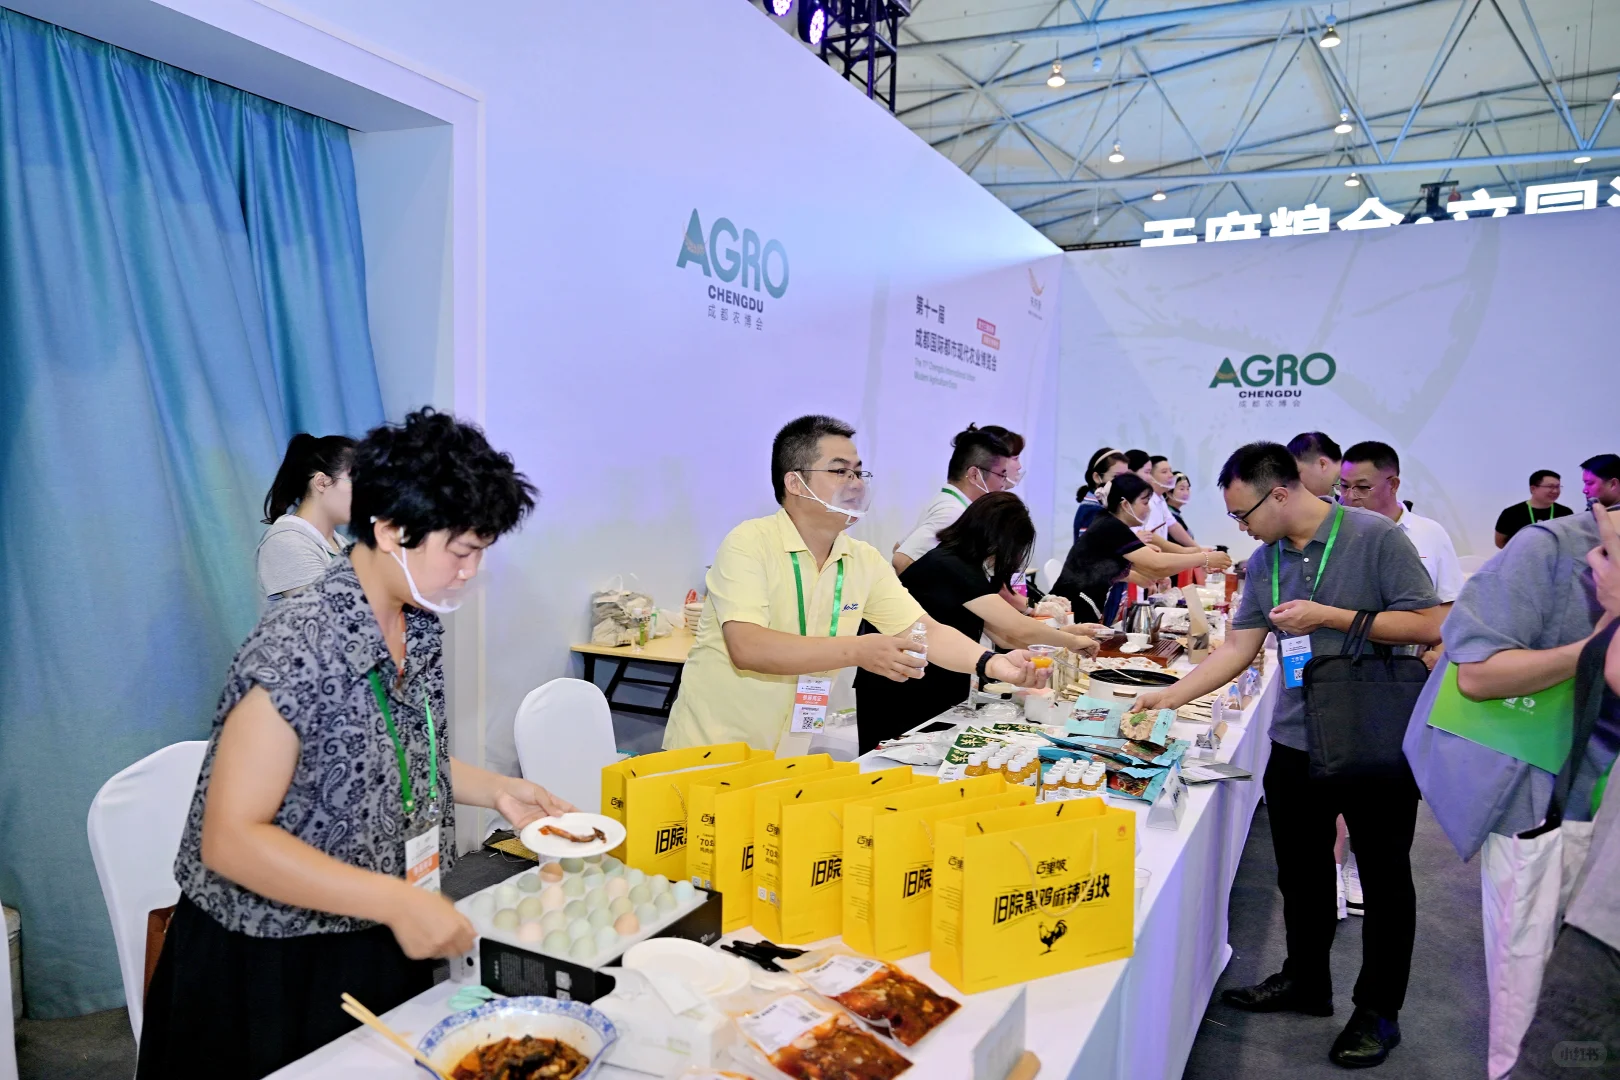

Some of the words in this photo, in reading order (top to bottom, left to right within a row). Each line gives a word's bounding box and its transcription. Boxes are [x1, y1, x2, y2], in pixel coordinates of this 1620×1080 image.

[676, 208, 789, 298] AGRO
[708, 284, 764, 314] CHENGDU
[916, 294, 945, 325] 第十一届
[708, 303, 763, 331] 成都农博会
[1208, 352, 1337, 388] AGRO
[1239, 390, 1302, 398] CHENGDU
[1239, 399, 1301, 408] 成都农博会
[655, 824, 687, 854] 旧院
[993, 873, 1111, 925] 旧院黑鸡麻辣鸡块
